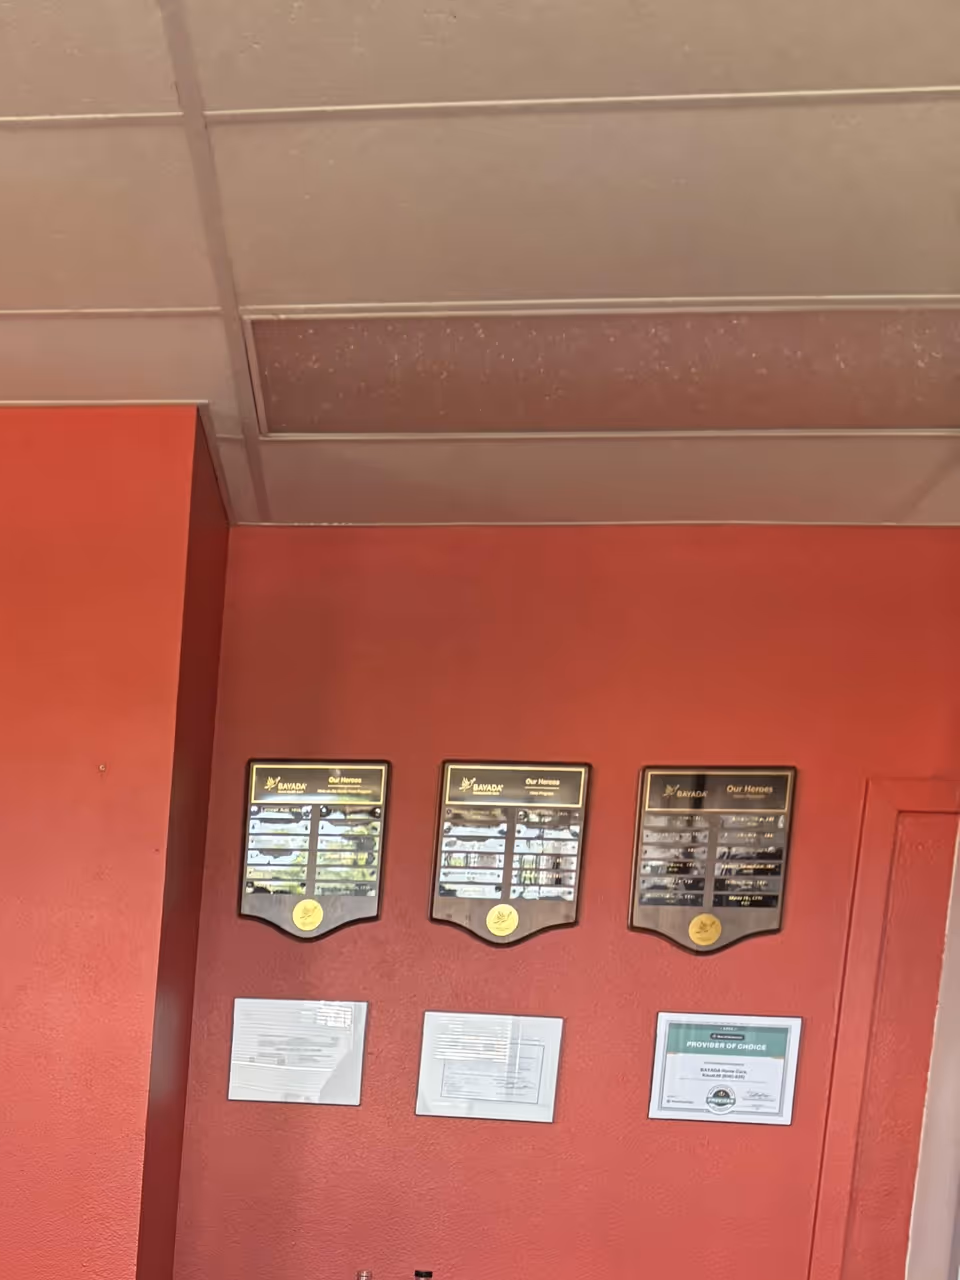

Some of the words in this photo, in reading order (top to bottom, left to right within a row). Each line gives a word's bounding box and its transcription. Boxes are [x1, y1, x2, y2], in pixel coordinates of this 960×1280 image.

[328, 776, 340, 784] Our
[341, 776, 362, 784] Heroes
[538, 778, 561, 786] Heroes
[277, 783, 308, 791] BAYADA
[473, 784, 504, 792] BAYADA
[727, 784, 742, 793] Our
[744, 785, 773, 794] Heroes
[677, 790, 708, 798] BAYADA
[686, 1041, 725, 1049] PROVIDER
[737, 1043, 767, 1051] CHOICE
